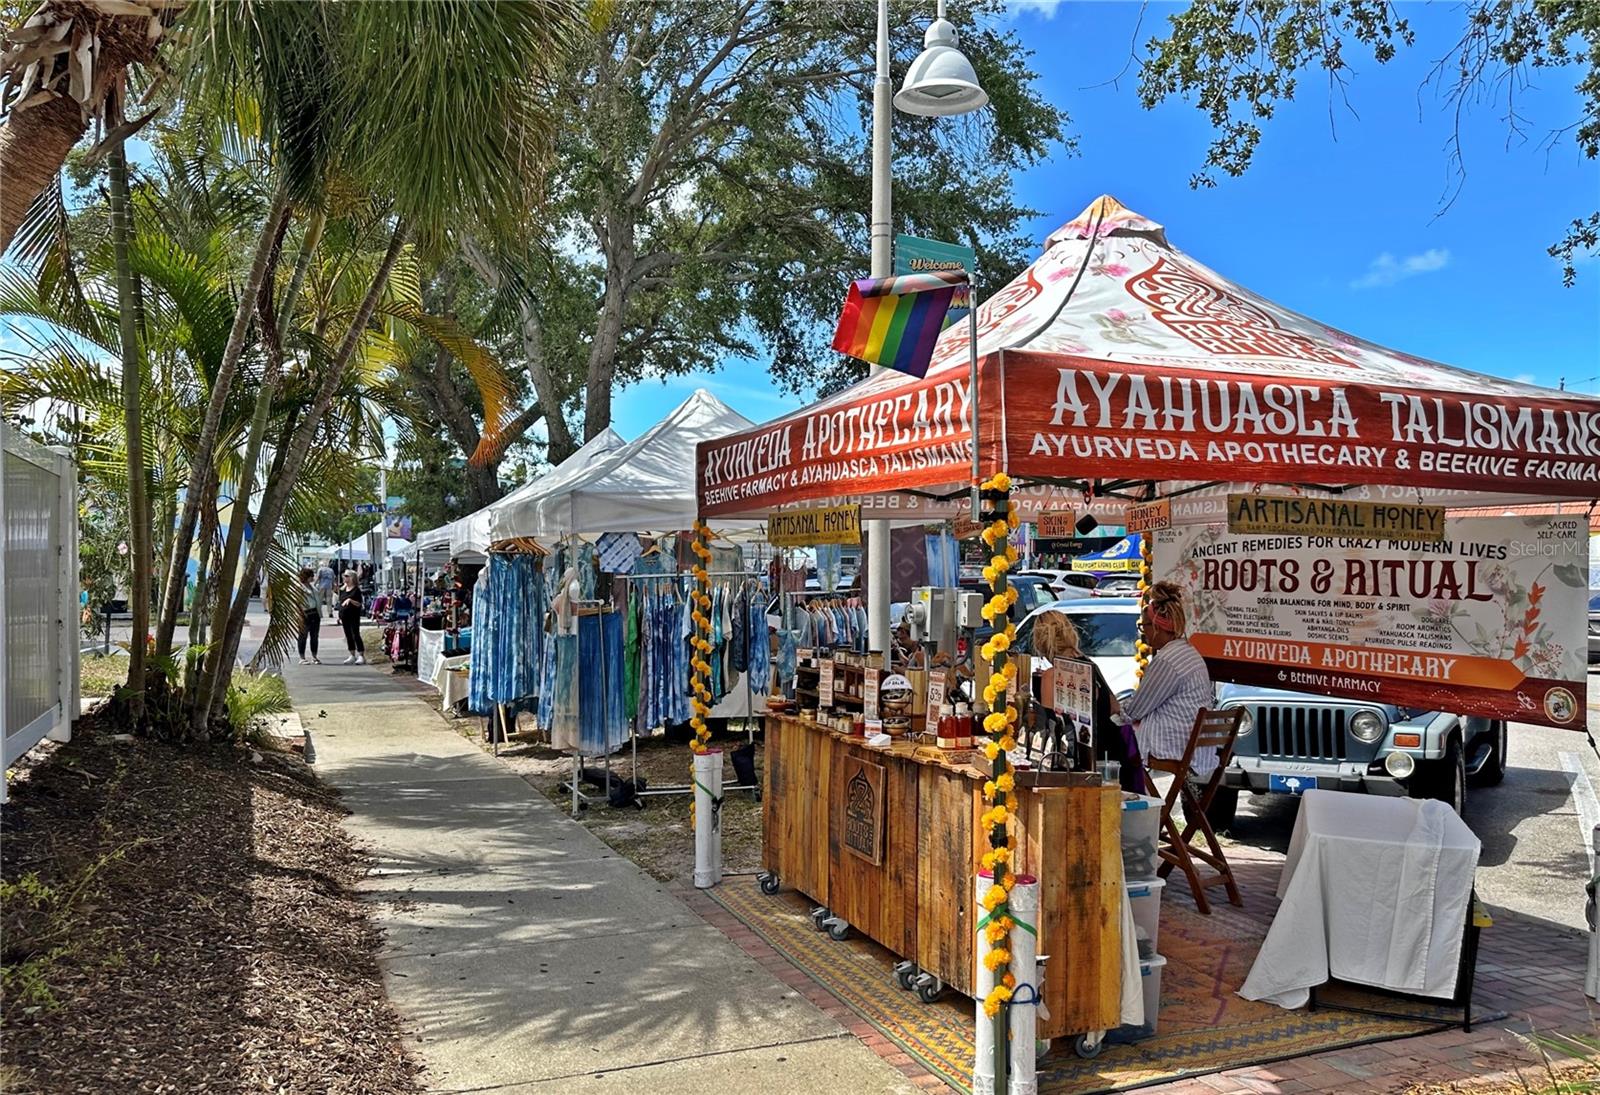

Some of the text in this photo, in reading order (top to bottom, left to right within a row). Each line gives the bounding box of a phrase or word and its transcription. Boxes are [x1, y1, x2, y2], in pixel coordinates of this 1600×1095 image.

[909, 258, 963, 270] Welcome
[1049, 368, 1359, 438] AYAHUASCA
[704, 377, 972, 486] AYURVEDA APOTHECARY
[1029, 432, 1600, 482] AYURVEDA APOTHECARY & BEEHIVE FARMA
[705, 438, 972, 505] BEEHIVE FARMACY & AYAHUASCA TALISMANS
[1043, 516, 1062, 526] SKIN
[1131, 505, 1161, 521] HONEY
[1237, 499, 1439, 531] ARTISANAL HONEY
[771, 509, 856, 536] ARTISANAL HONEY
[1128, 516, 1167, 532] ELIXIRS
[1548, 521, 1577, 530] SACRED
[1046, 526, 1065, 536] HAIR
[1537, 531, 1576, 540] SELF-CARE
[1191, 535, 1507, 560] ANCIENT REMEDIES FOR CRAZY MODERN LIVES
[1202, 559, 1493, 602] ROOTS & RITUAL
[1257, 597, 1410, 611] DOSHA BALANCING FOR MIND, BODY & SPIRIT
[1379, 630, 1452, 641] AYAHUASCA TALISMANS
[1417, 625, 1451, 633] AROMATICS
[1397, 639, 1417, 647] PULSE
[1419, 641, 1452, 650] READINGS
[1223, 639, 1457, 680] AYURVEDA APOTHECARY
[1277, 669, 1380, 693] & BEEHIVE FARMACY
